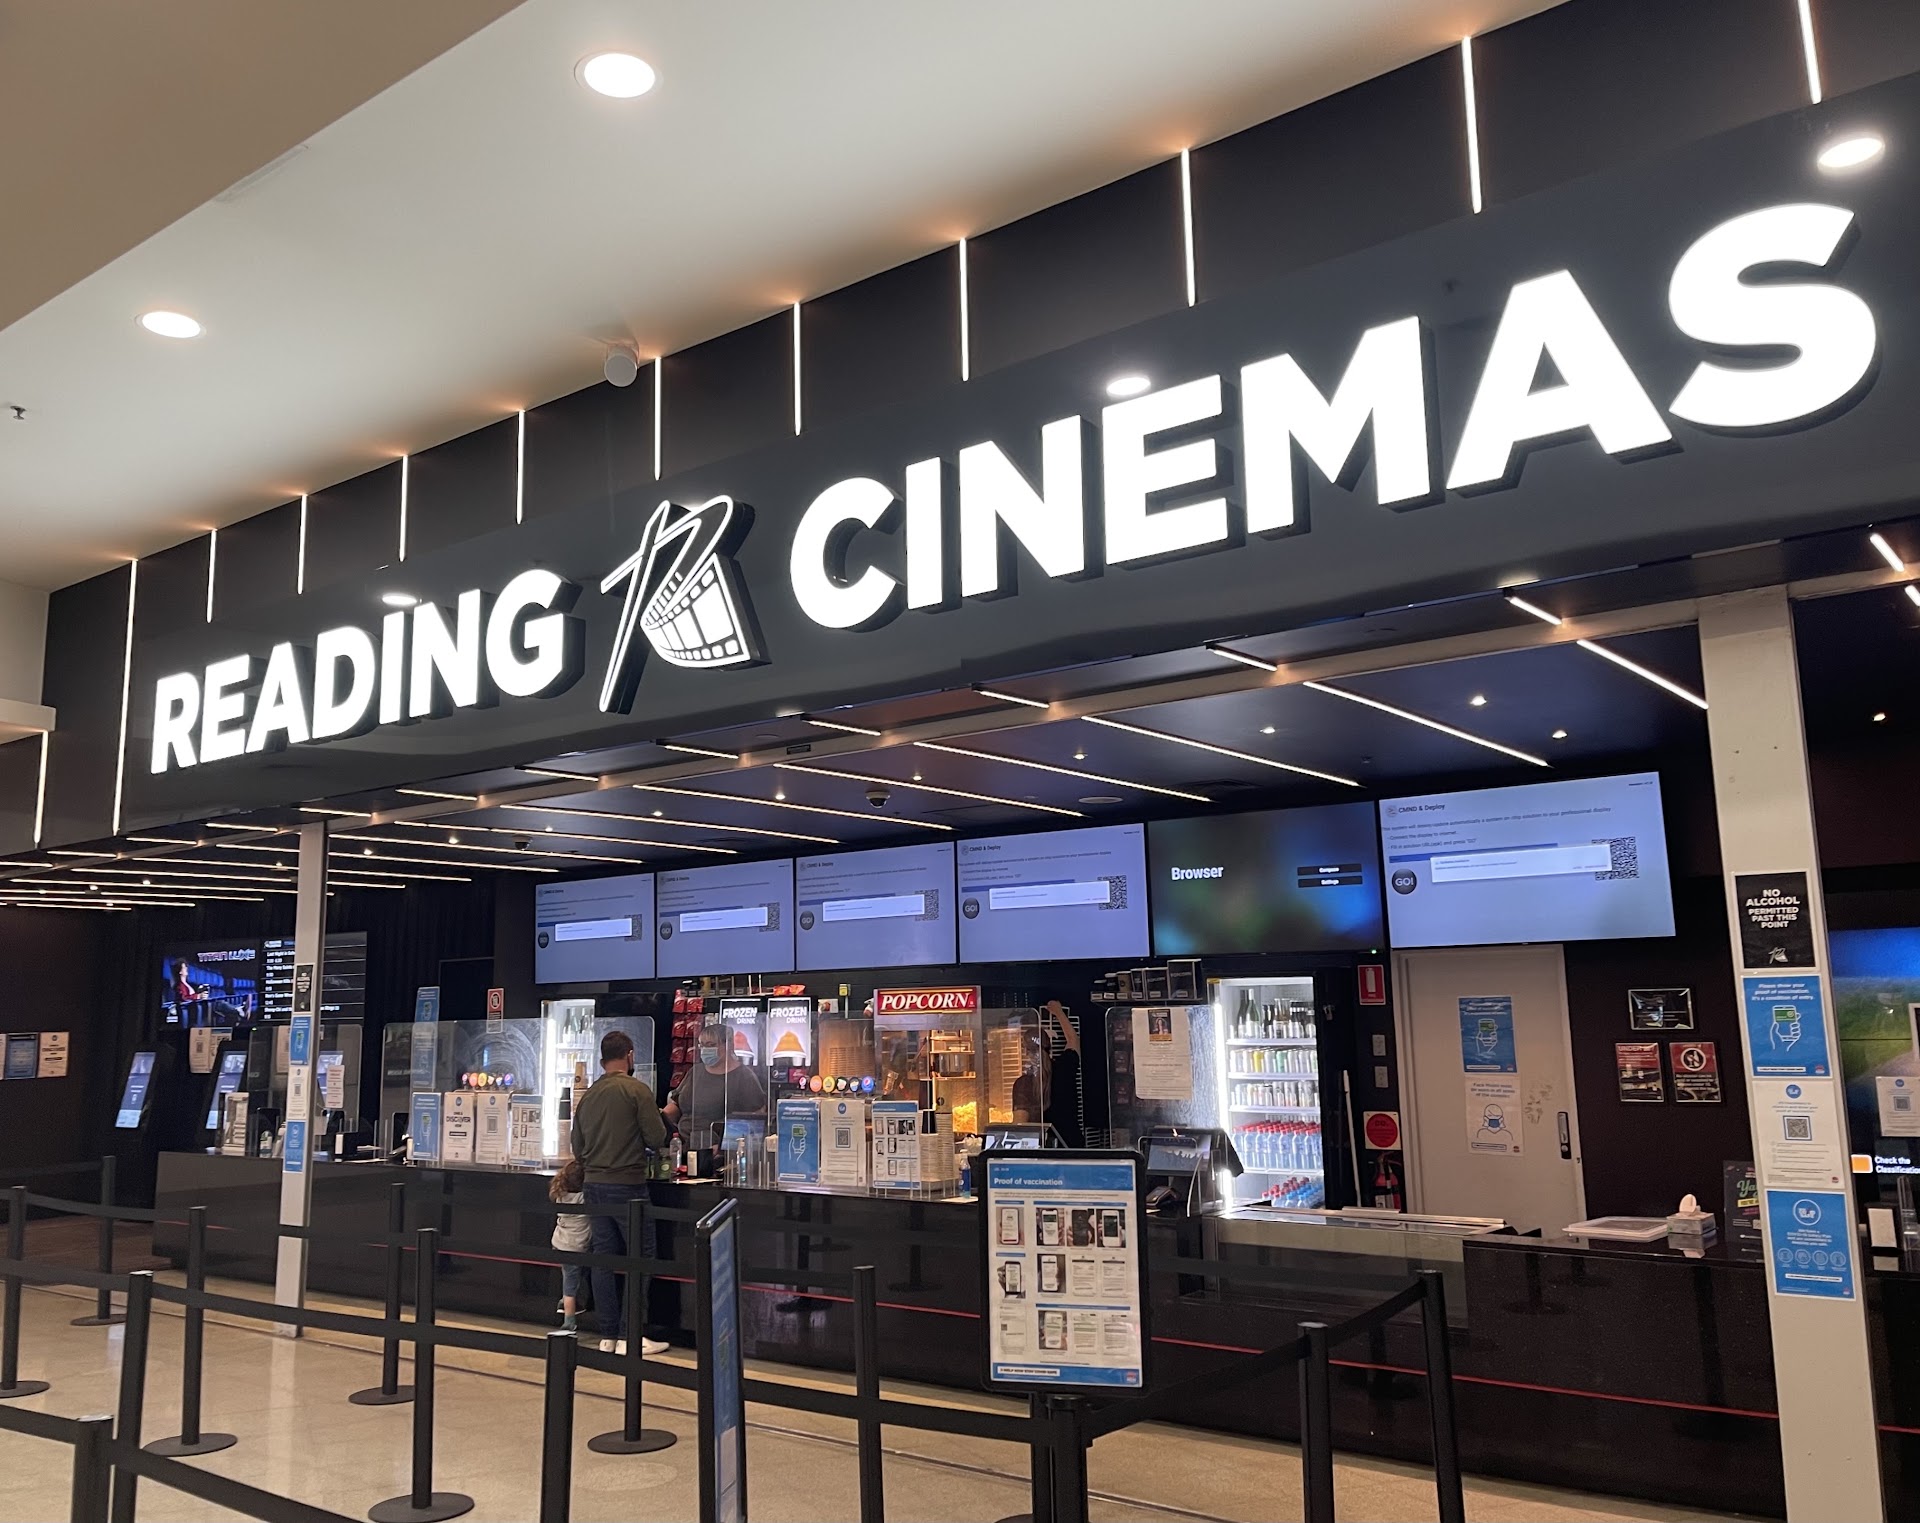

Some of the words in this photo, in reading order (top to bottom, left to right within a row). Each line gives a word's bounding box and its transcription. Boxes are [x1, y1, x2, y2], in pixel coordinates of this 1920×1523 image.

[150, 568, 566, 775] READING
[790, 204, 1876, 629] CINEMAS
[1424, 803, 1446, 812] Deploy
[1171, 865, 1225, 881] Browser
[1395, 876, 1414, 887] GO!
[1763, 888, 1781, 898] NO
[1745, 896, 1801, 907] ALCOHOL
[1748, 906, 1800, 916] PERMITTED
[1752, 914, 1775, 922] PAST
[1776, 913, 1798, 921] THIS
[1761, 920, 1790, 929] POINT
[197, 951, 228, 963] TITAN
[228, 948, 256, 962] LUXE
[880, 992, 971, 1011] POPCORN
[722, 1006, 758, 1019] FROZEN
[770, 1006, 808, 1019] FROZEN
[736, 1017, 756, 1025] DRINK
[786, 1016, 807, 1024] DRINK
[446, 1115, 471, 1123] DISCOVER
[1874, 1155, 1898, 1165] Check
[1898, 1156, 1911, 1165] the
[1876, 1165, 1920, 1175] Classificatio
[993, 1177, 1013, 1185] Proof
[1014, 1177, 1022, 1185] of
[1023, 1178, 1063, 1186] vaccination
